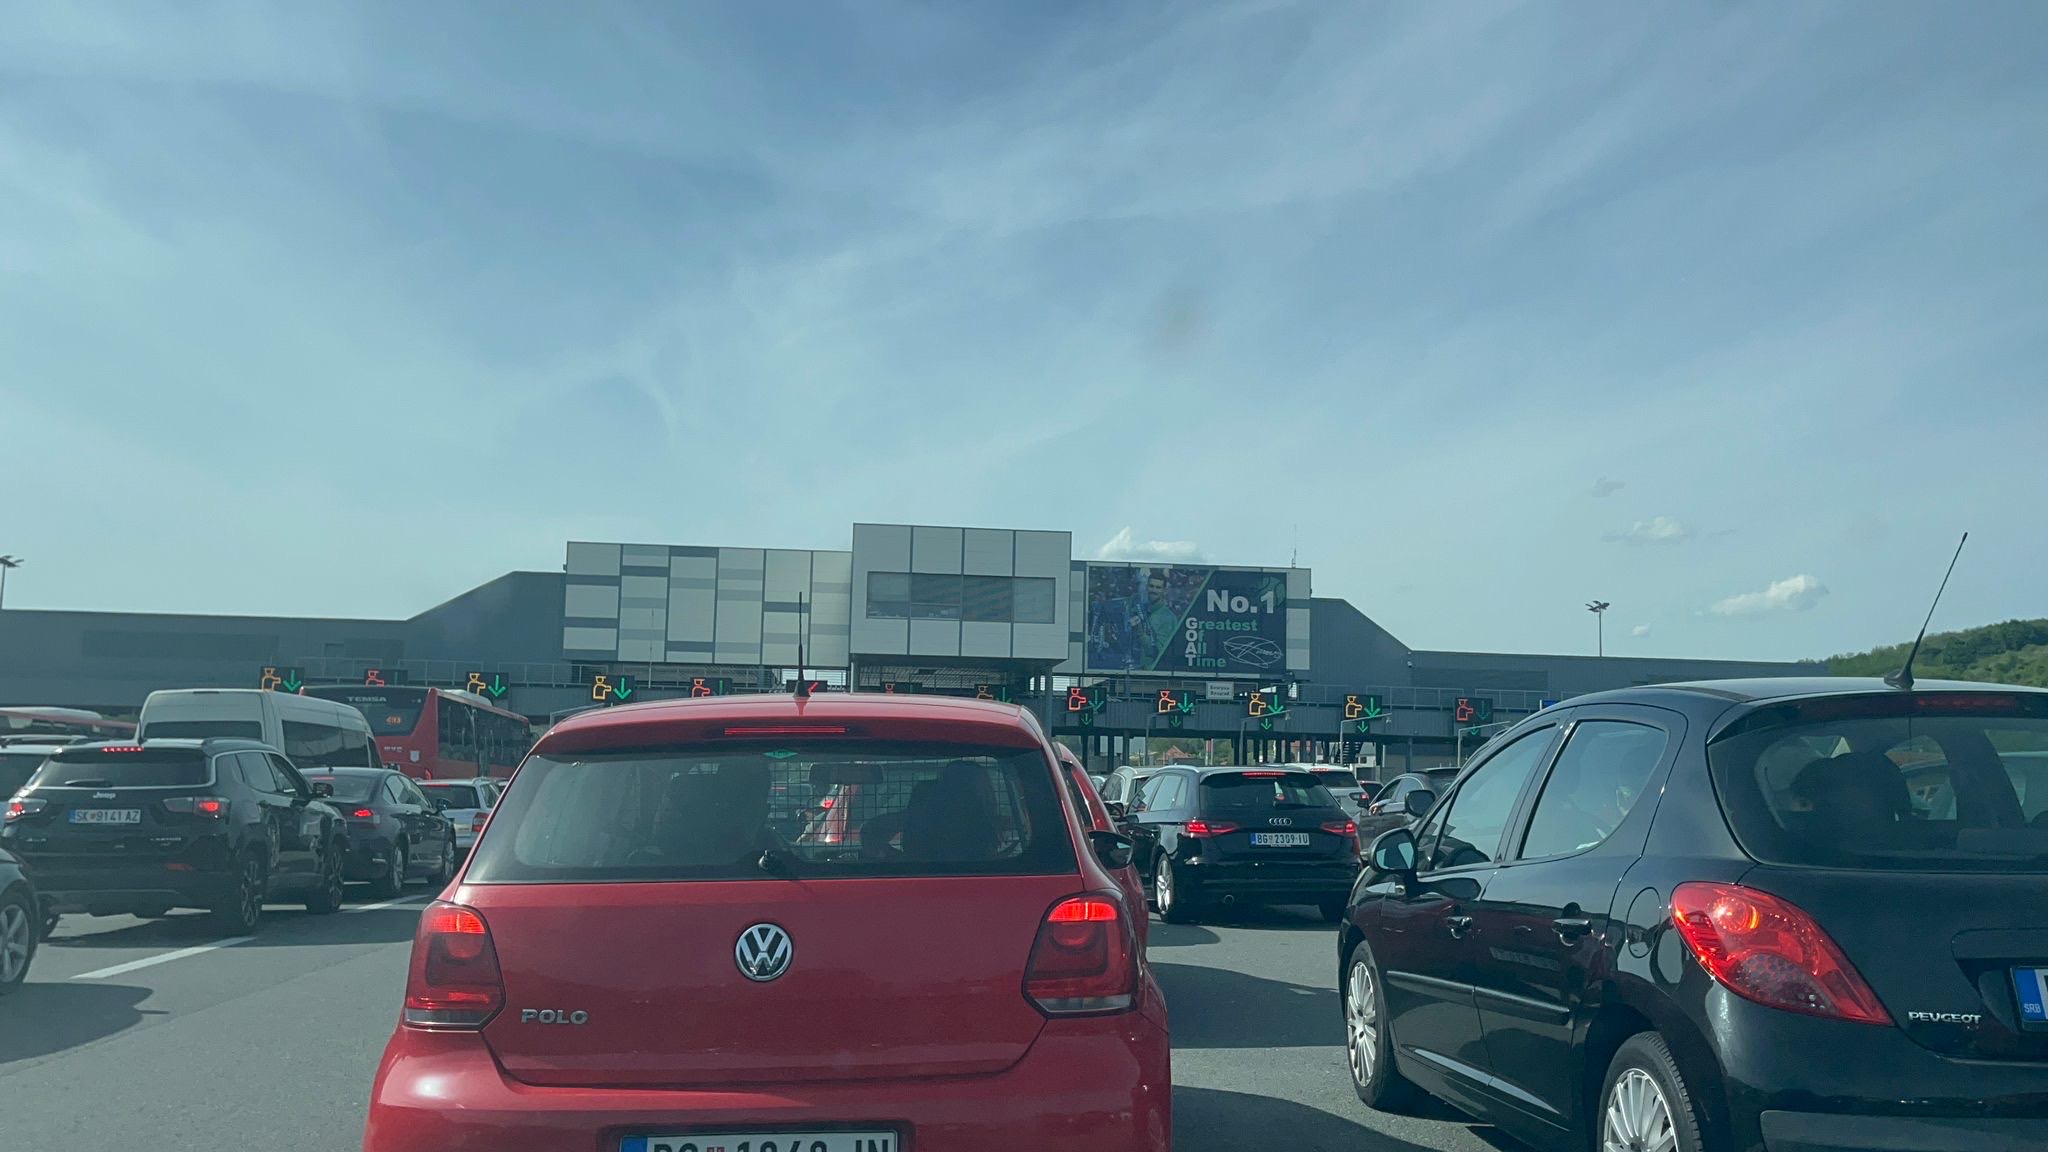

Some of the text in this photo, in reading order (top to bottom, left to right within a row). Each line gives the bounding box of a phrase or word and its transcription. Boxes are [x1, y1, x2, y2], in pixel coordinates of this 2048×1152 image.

[1185, 617, 1258, 631] Greatest
[1185, 629, 1205, 642] Of
[1185, 641, 1207, 655] All
[1185, 654, 1227, 668] Time
[76, 811, 140, 822] SK 9141 AZ
[1257, 834, 1268, 844] BG
[2023, 1003, 2042, 1014] SRB
[521, 1008, 589, 1025] POLO
[1908, 1011, 1982, 1024] PEUGEOT
